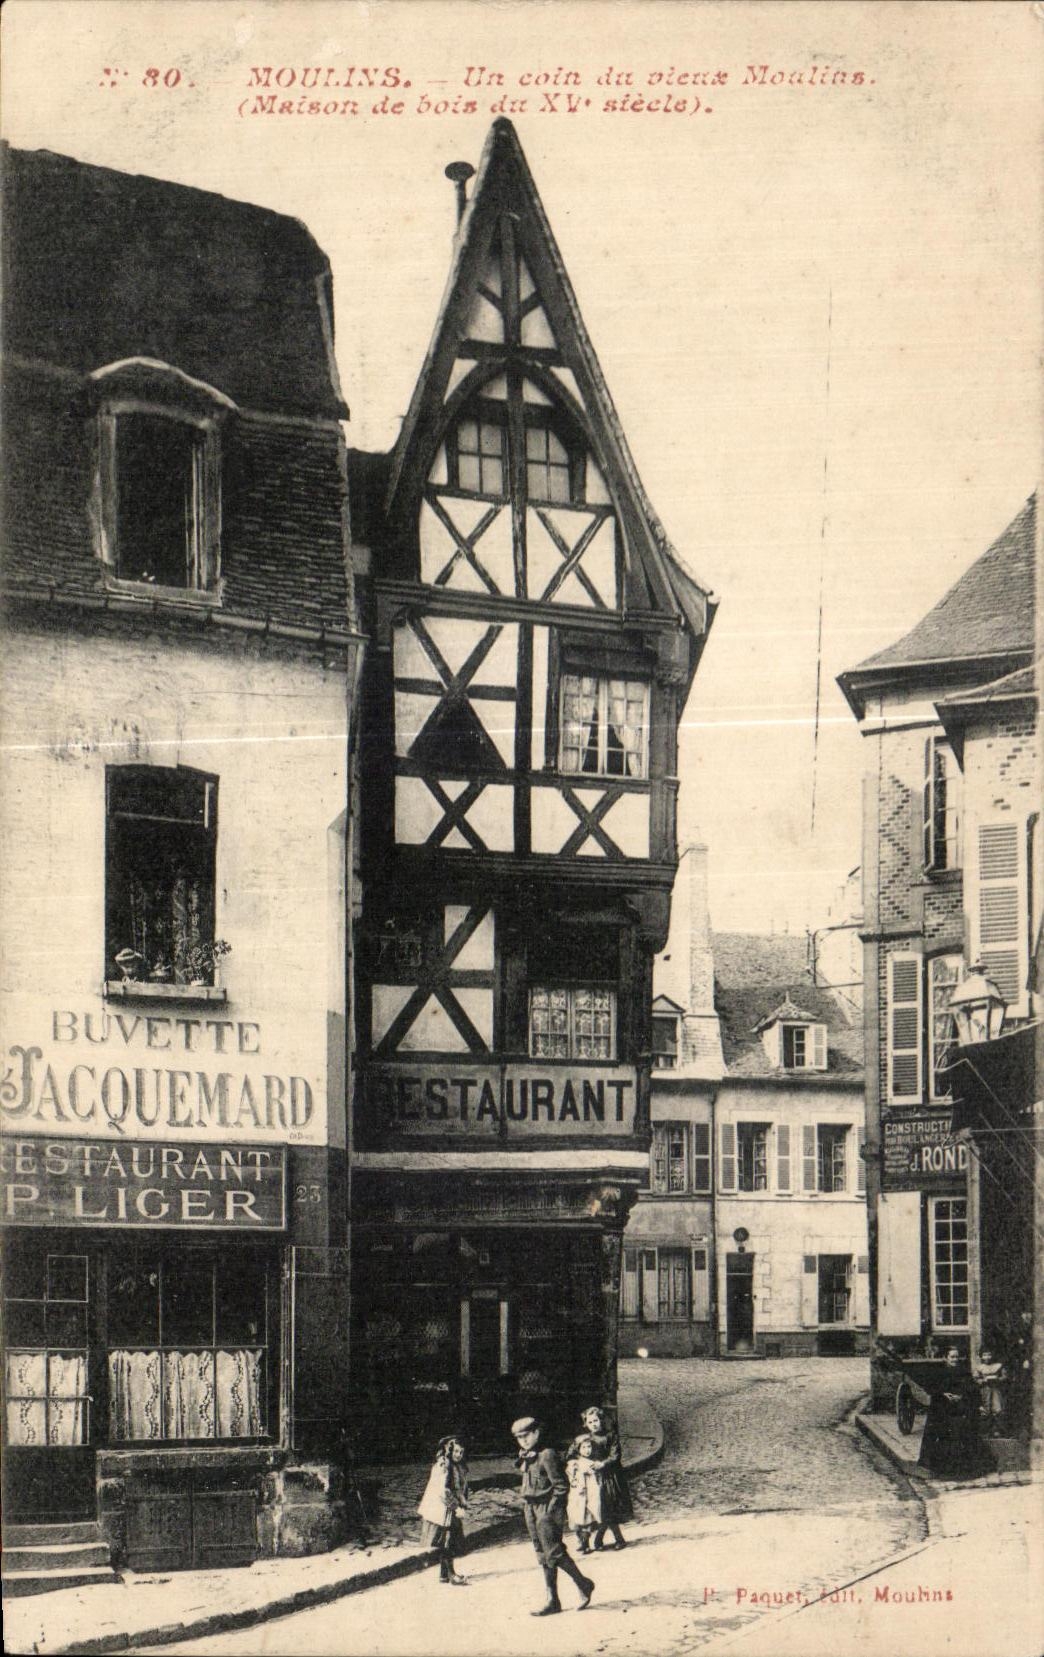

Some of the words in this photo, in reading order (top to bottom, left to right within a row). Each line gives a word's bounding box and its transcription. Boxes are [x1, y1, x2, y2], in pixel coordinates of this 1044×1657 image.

[52, 1010, 261, 1055] BUVETTE
[0, 1044, 314, 1134] JACQUEMARD
[884, 1119, 953, 1135] CONSTRUCTI
[73, 1186, 264, 1221] LIGER
